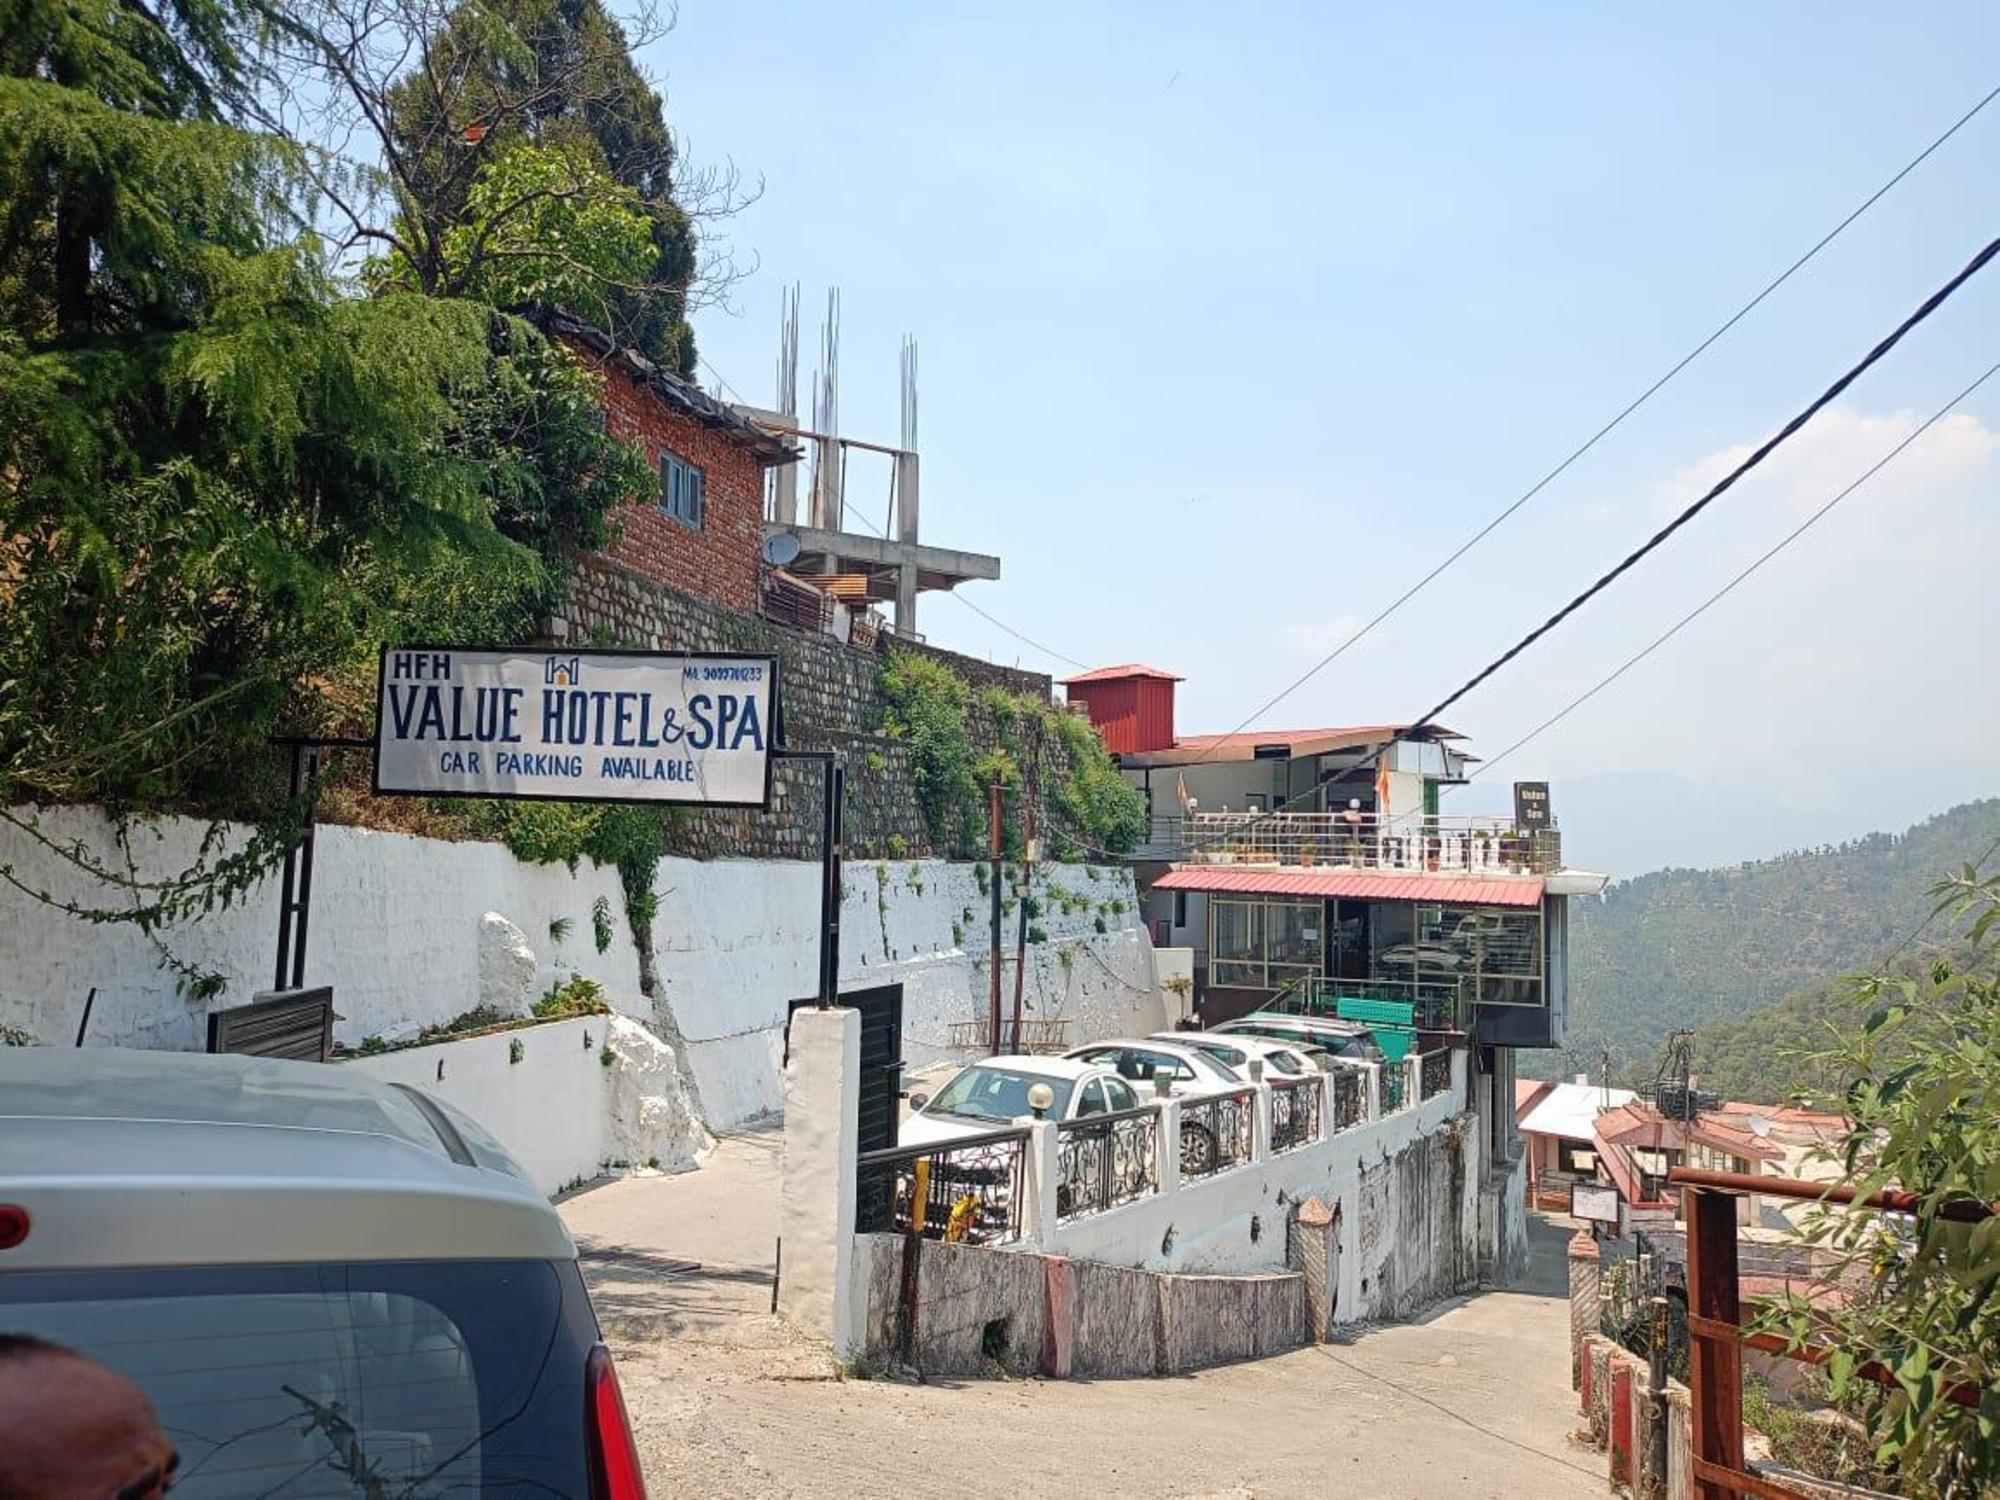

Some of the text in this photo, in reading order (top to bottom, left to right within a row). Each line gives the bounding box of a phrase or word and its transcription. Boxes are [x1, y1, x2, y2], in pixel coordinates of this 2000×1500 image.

[394, 653, 450, 680] HFH
[388, 684, 524, 744] VALUE
[541, 690, 660, 747] HOTEL
[687, 694, 765, 752] SPA
[441, 752, 695, 782] CAR PARKING AVAILABLE
